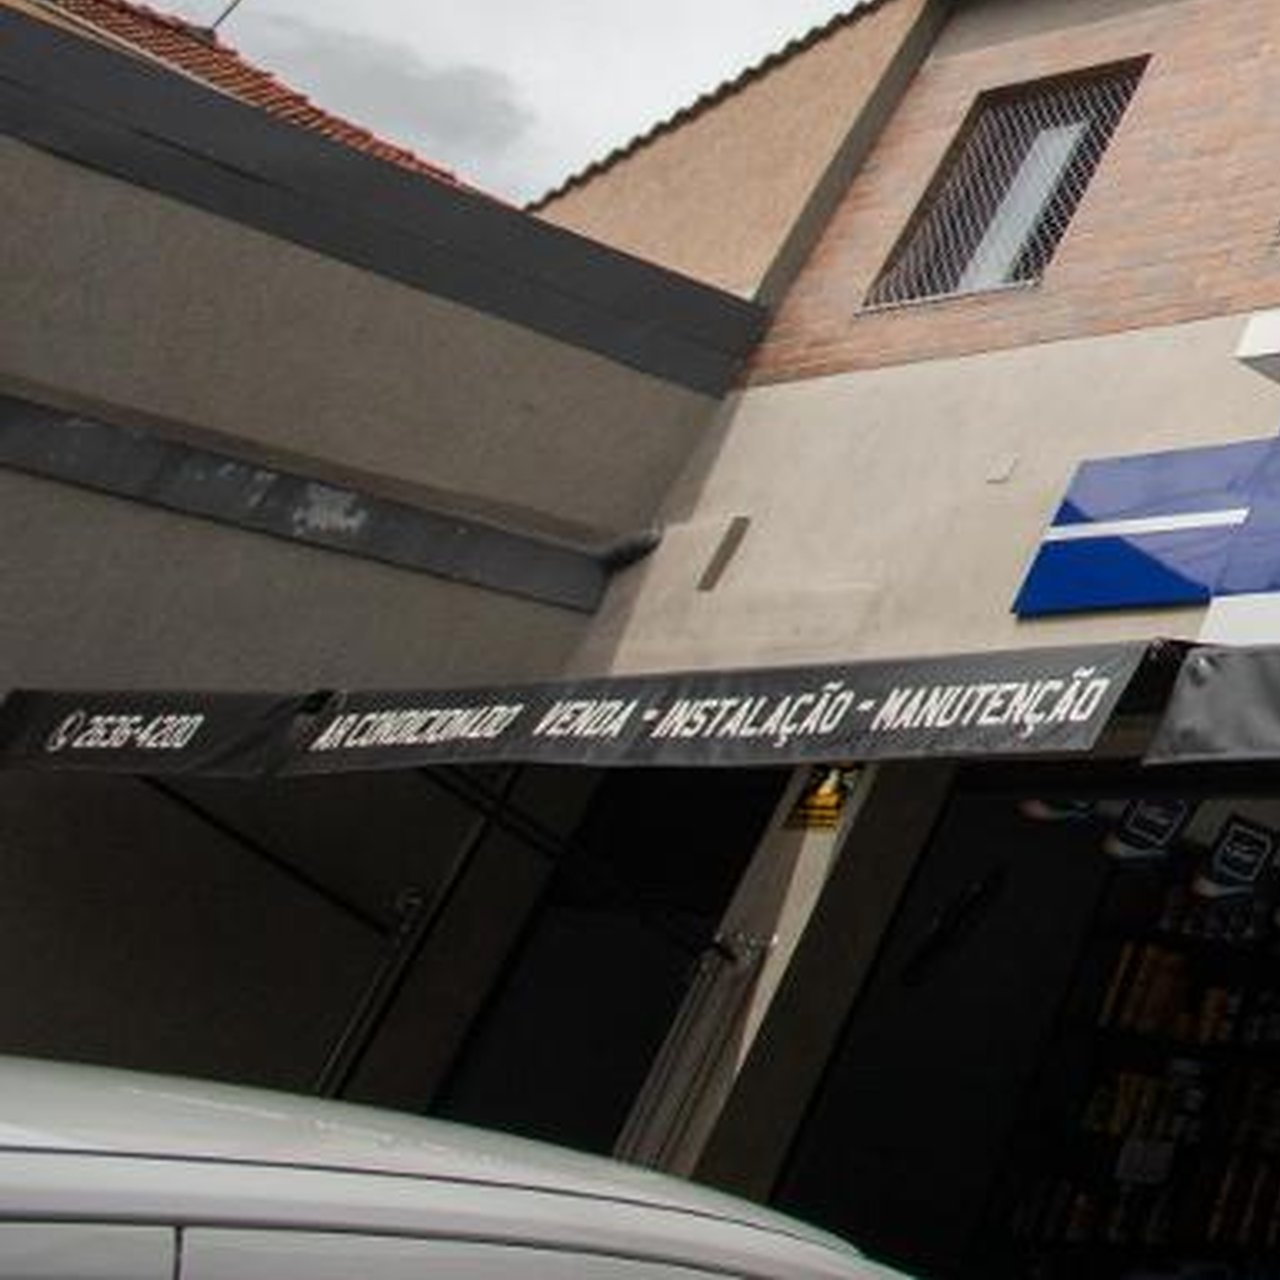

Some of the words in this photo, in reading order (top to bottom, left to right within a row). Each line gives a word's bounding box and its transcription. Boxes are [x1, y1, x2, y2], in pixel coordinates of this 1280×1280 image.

[532, 698, 638, 738] VENDA
[651, 681, 855, 748] INSTALAÇÃO
[871, 666, 1112, 739] MANUTENÇÃO
